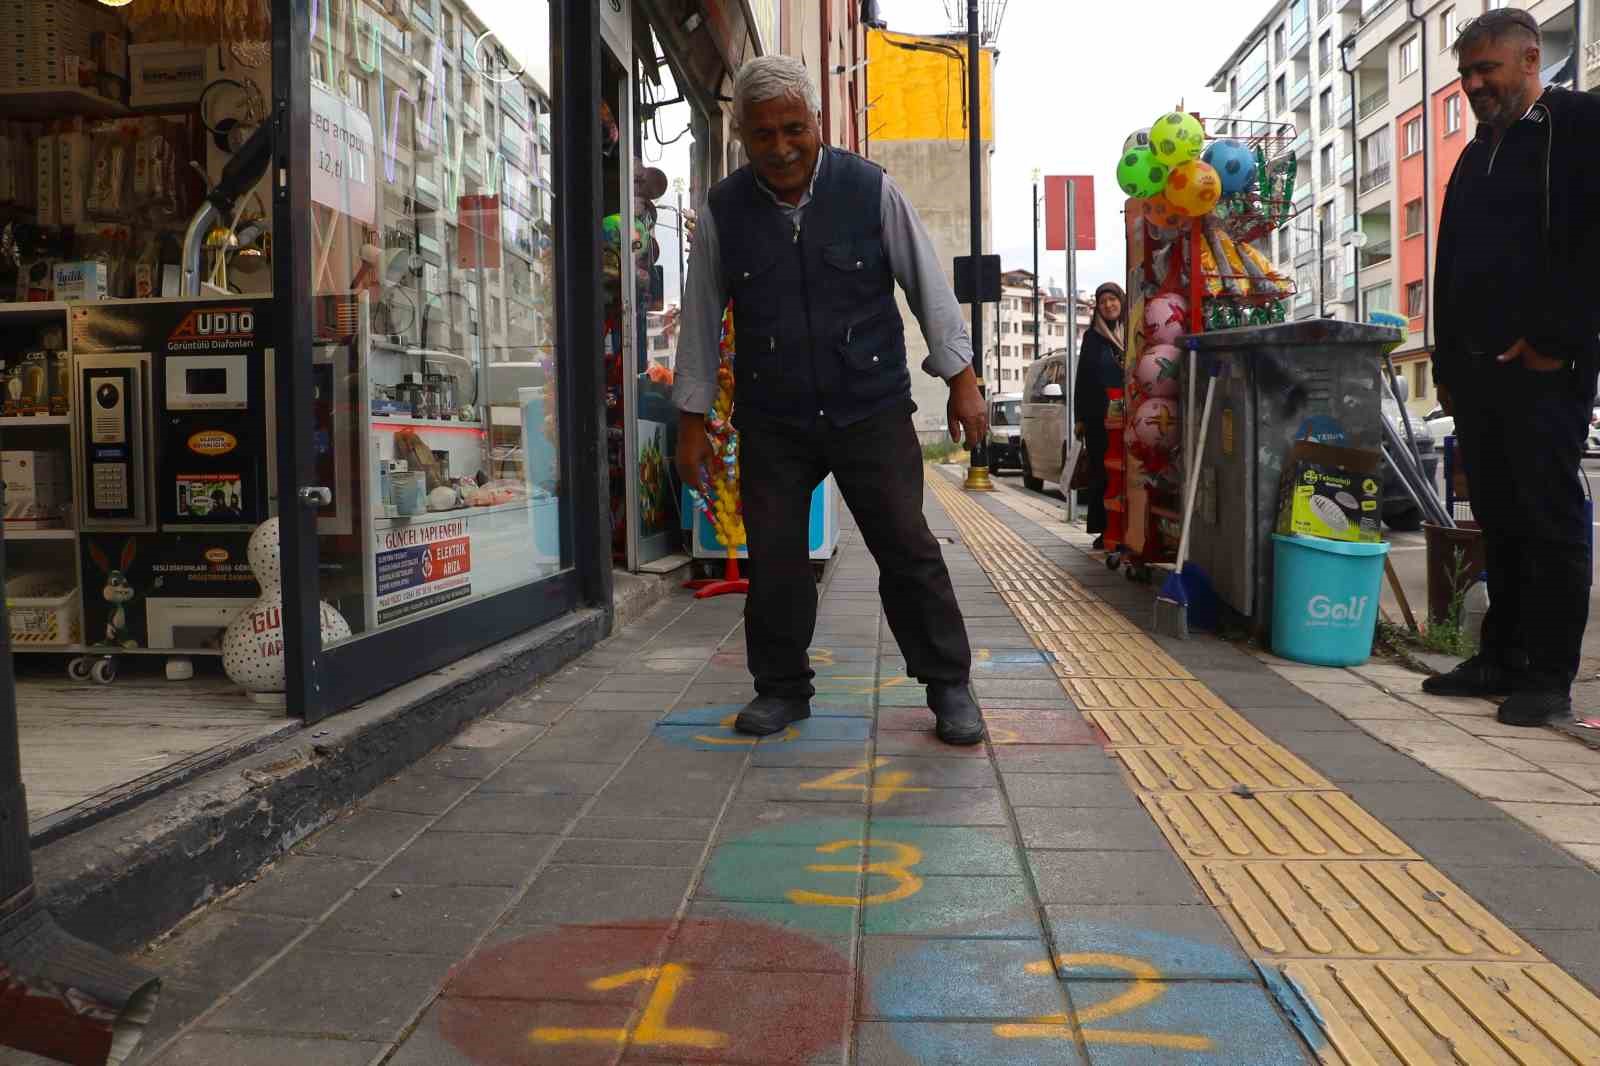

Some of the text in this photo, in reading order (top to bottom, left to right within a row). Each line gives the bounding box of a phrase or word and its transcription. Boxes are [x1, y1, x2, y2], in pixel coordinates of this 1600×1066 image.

[1307, 594, 1369, 621] Golf
[799, 755, 931, 804] 4
[785, 839, 924, 907] 3
[528, 951, 1219, 1052] 1 2
